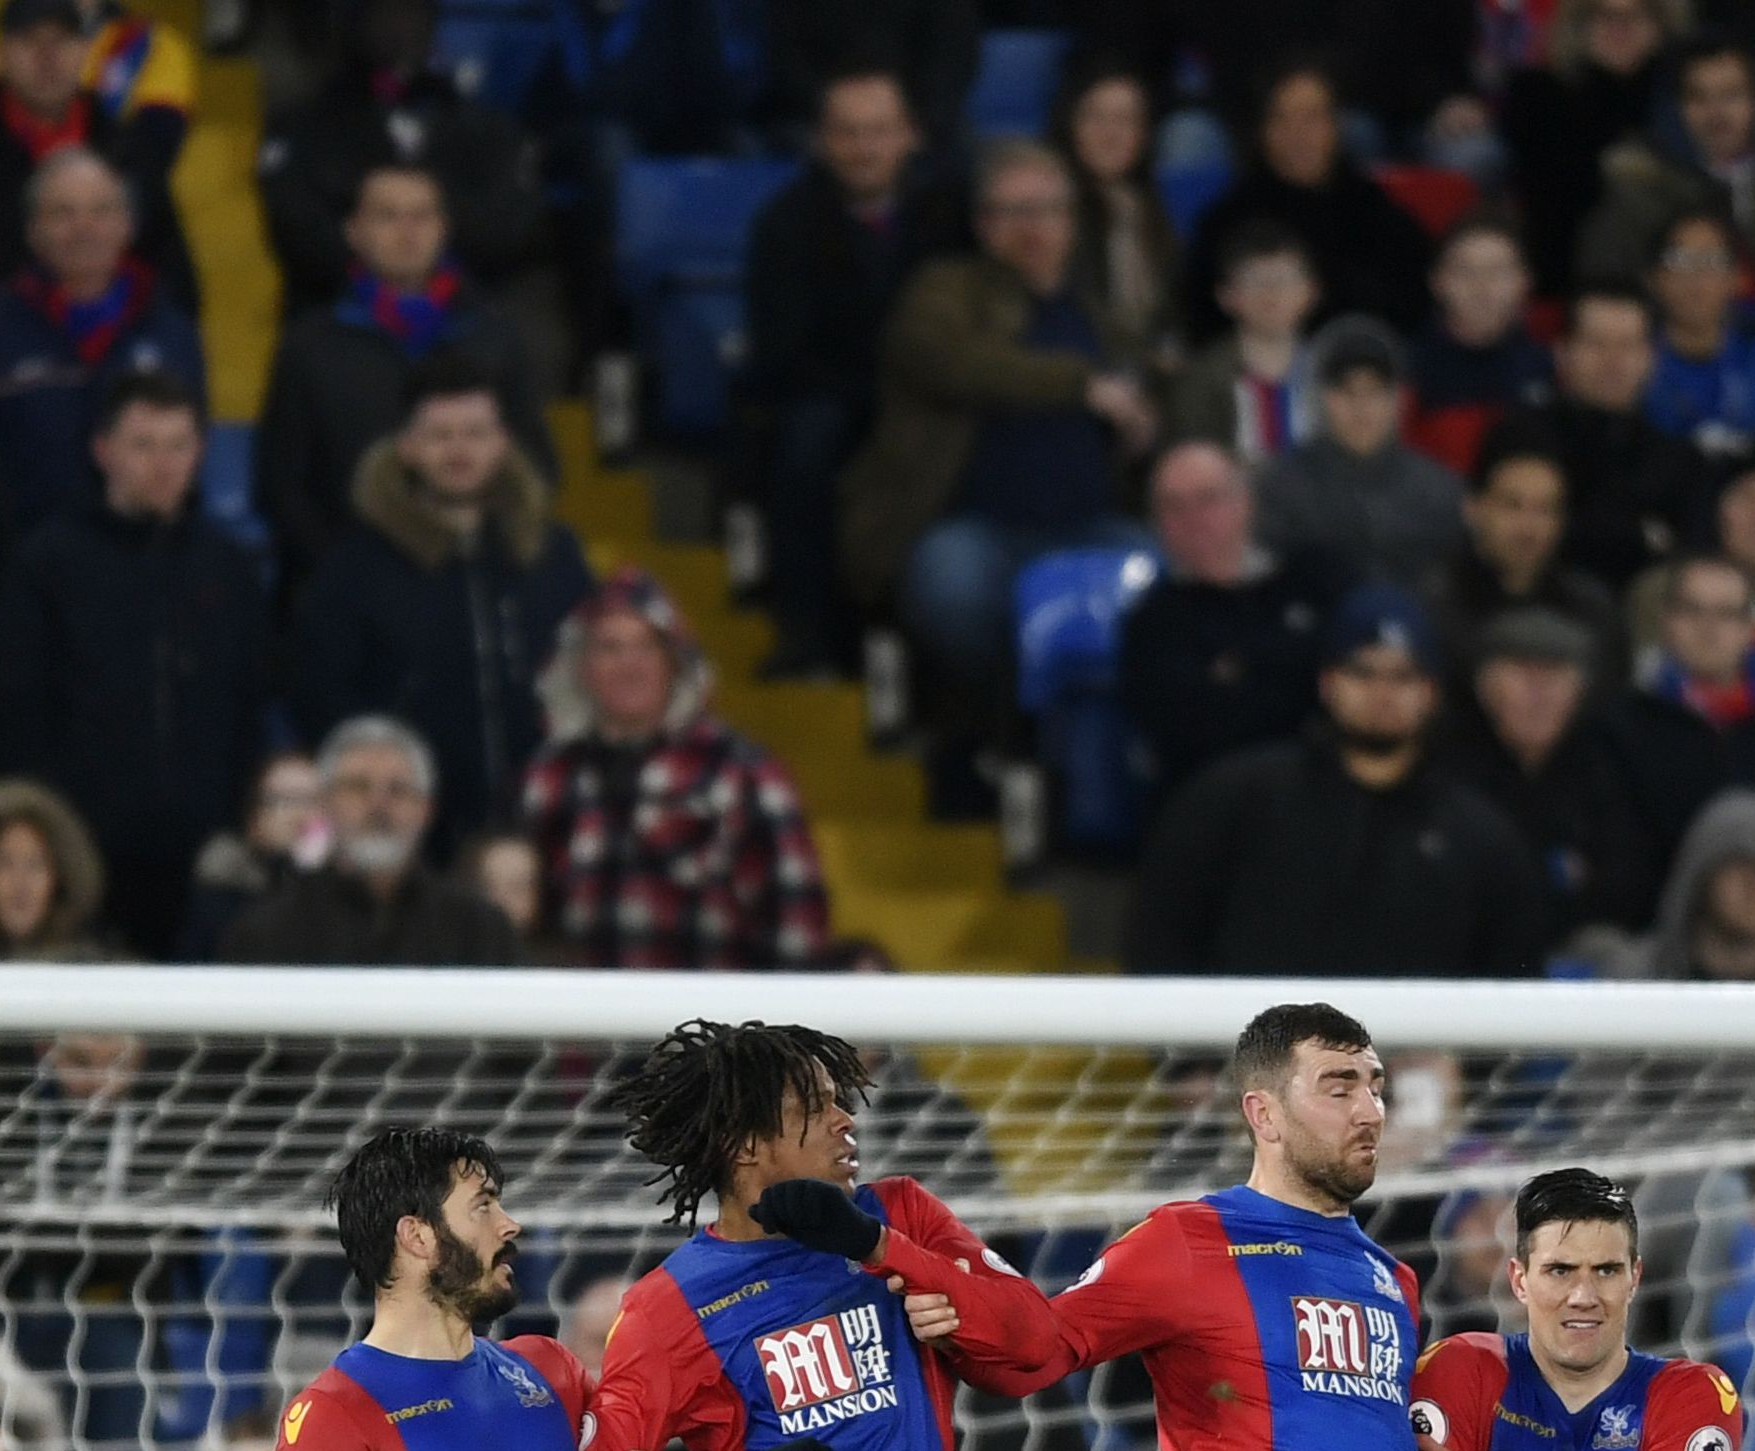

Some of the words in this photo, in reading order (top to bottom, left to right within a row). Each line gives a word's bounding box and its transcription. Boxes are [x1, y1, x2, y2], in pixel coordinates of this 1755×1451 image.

[1227, 1241, 1304, 1258] macron
[696, 1278, 770, 1319] macron
[1301, 1370, 1404, 1407] MANSION
[385, 1397, 454, 1425] macron
[778, 1382, 899, 1436] MANSION
